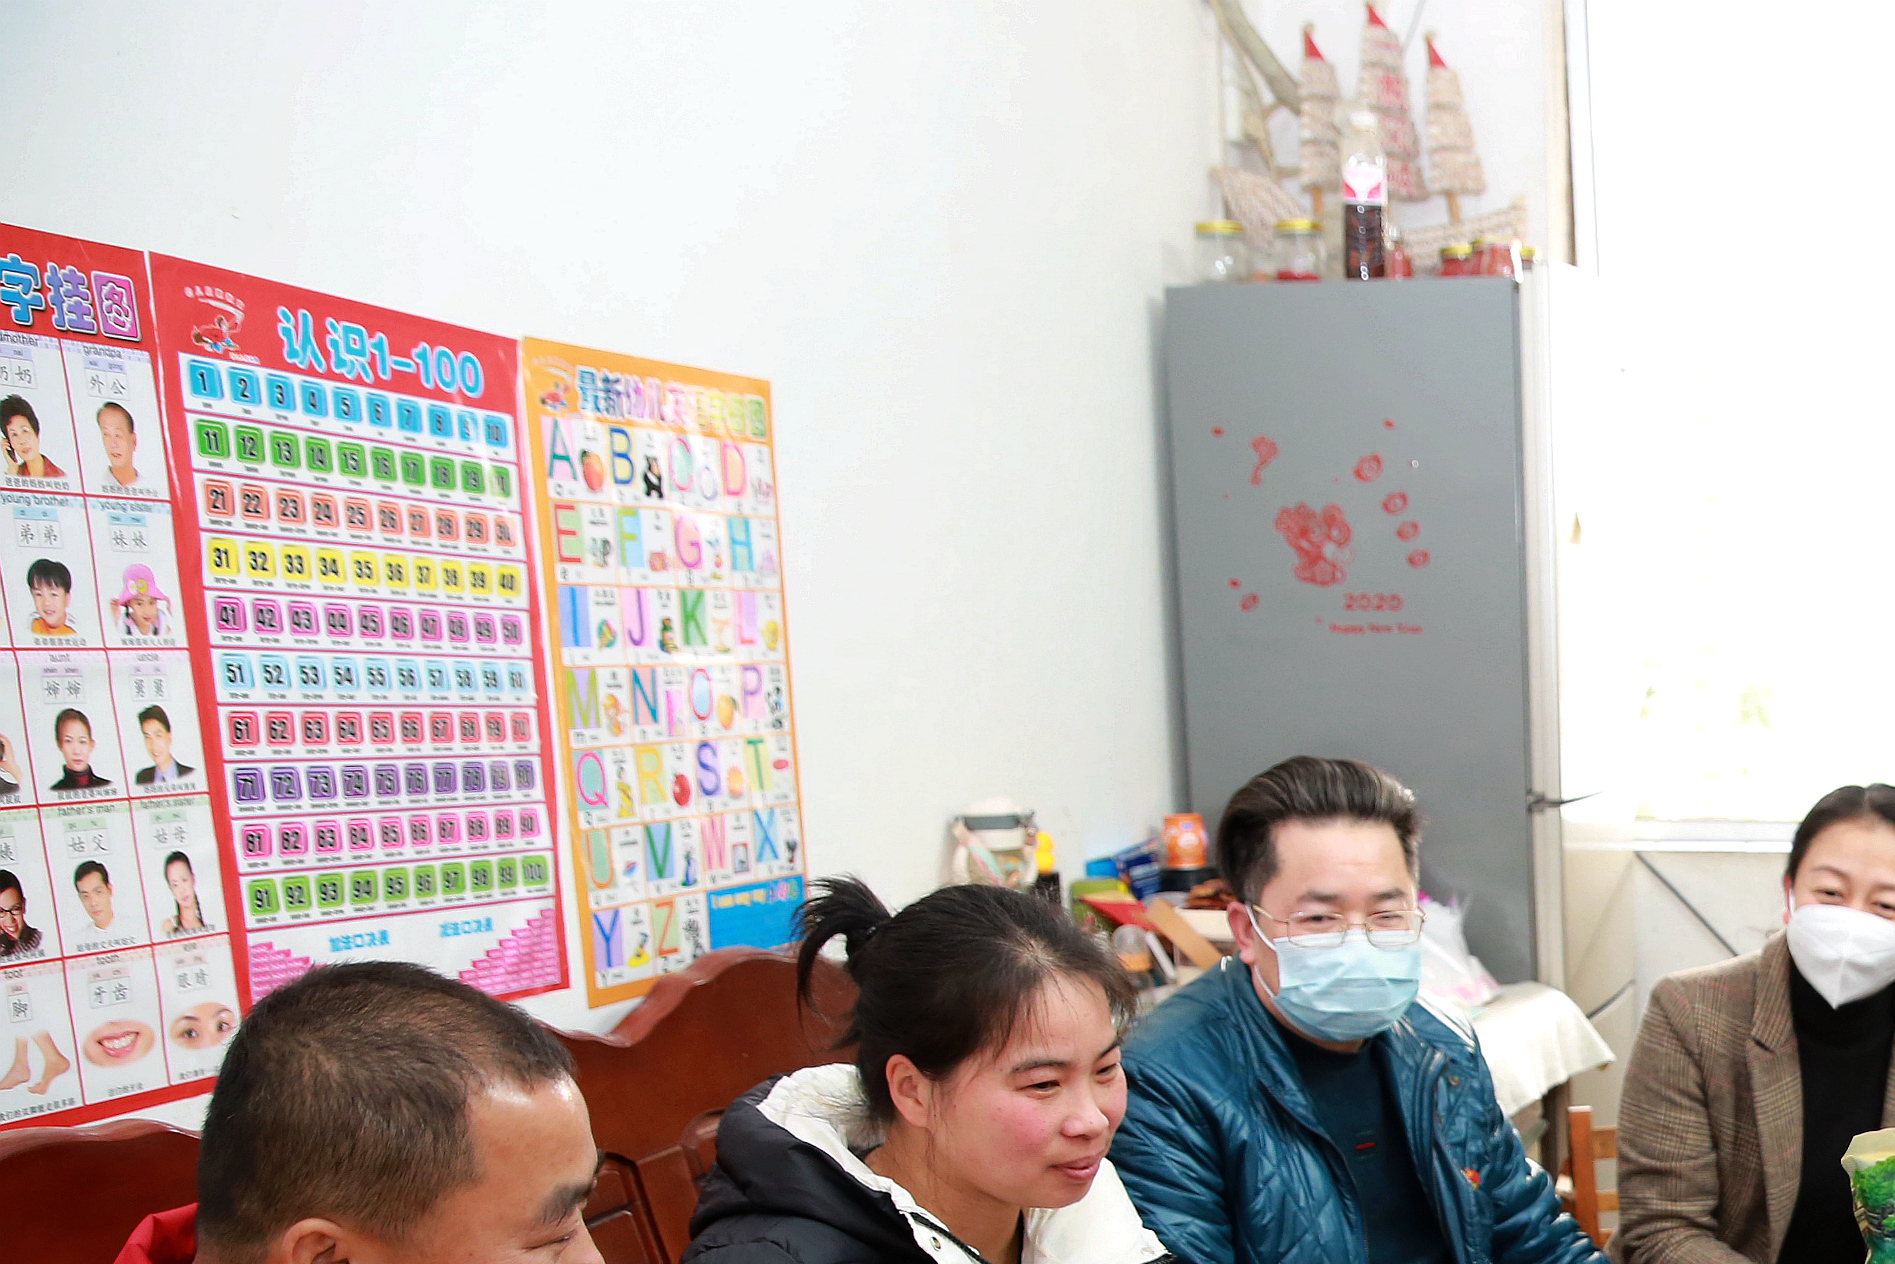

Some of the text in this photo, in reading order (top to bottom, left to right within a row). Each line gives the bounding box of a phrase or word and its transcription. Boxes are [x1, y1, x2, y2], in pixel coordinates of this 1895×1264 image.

[83, 345, 122, 359] grandpa
[277, 305, 484, 399] 认识1-100
[90, 374, 126, 395] 外公
[198, 371, 207, 392] 1
[238, 378, 249, 398] 2
[275, 384, 285, 405] 3
[341, 397, 350, 416] 5
[404, 407, 412, 427] 7
[204, 429, 219, 448] 11
[240, 436, 257, 458] 12
[275, 440, 292, 462] 13
[549, 419, 578, 481] A
[610, 428, 634, 484] B
[722, 442, 747, 495] D
[0, 493, 70, 507] young brother
[210, 488, 366, 525] 21 22 23 24 25
[20, 524, 58, 544] 弟弟
[554, 504, 582, 563] E
[619, 509, 638, 566] F
[728, 517, 755, 572] H
[213, 548, 430, 583] 31 32 33 34 35 36 37
[220, 606, 379, 632] 41 42 43 44 45
[627, 590, 645, 646] J
[681, 590, 708, 646] K
[226, 664, 385, 685] 51 52 53 54 55
[565, 669, 600, 728] M
[632, 669, 659, 724] N
[690, 668, 713, 721] O
[234, 720, 250, 740] 61
[305, 720, 323, 739] 63
[239, 776, 257, 798] 71
[274, 774, 296, 795] 72
[310, 773, 329, 794] 73
[577, 739, 764, 807] Q R S T
[247, 833, 262, 852] 81
[282, 830, 300, 850] 82
[318, 829, 336, 848] 83
[587, 829, 615, 889] U
[646, 823, 671, 879] V
[753, 809, 779, 863] X
[255, 889, 271, 909] 91
[288, 885, 304, 905] 92
[321, 882, 338, 901] 93
[593, 901, 679, 967] Y Z
